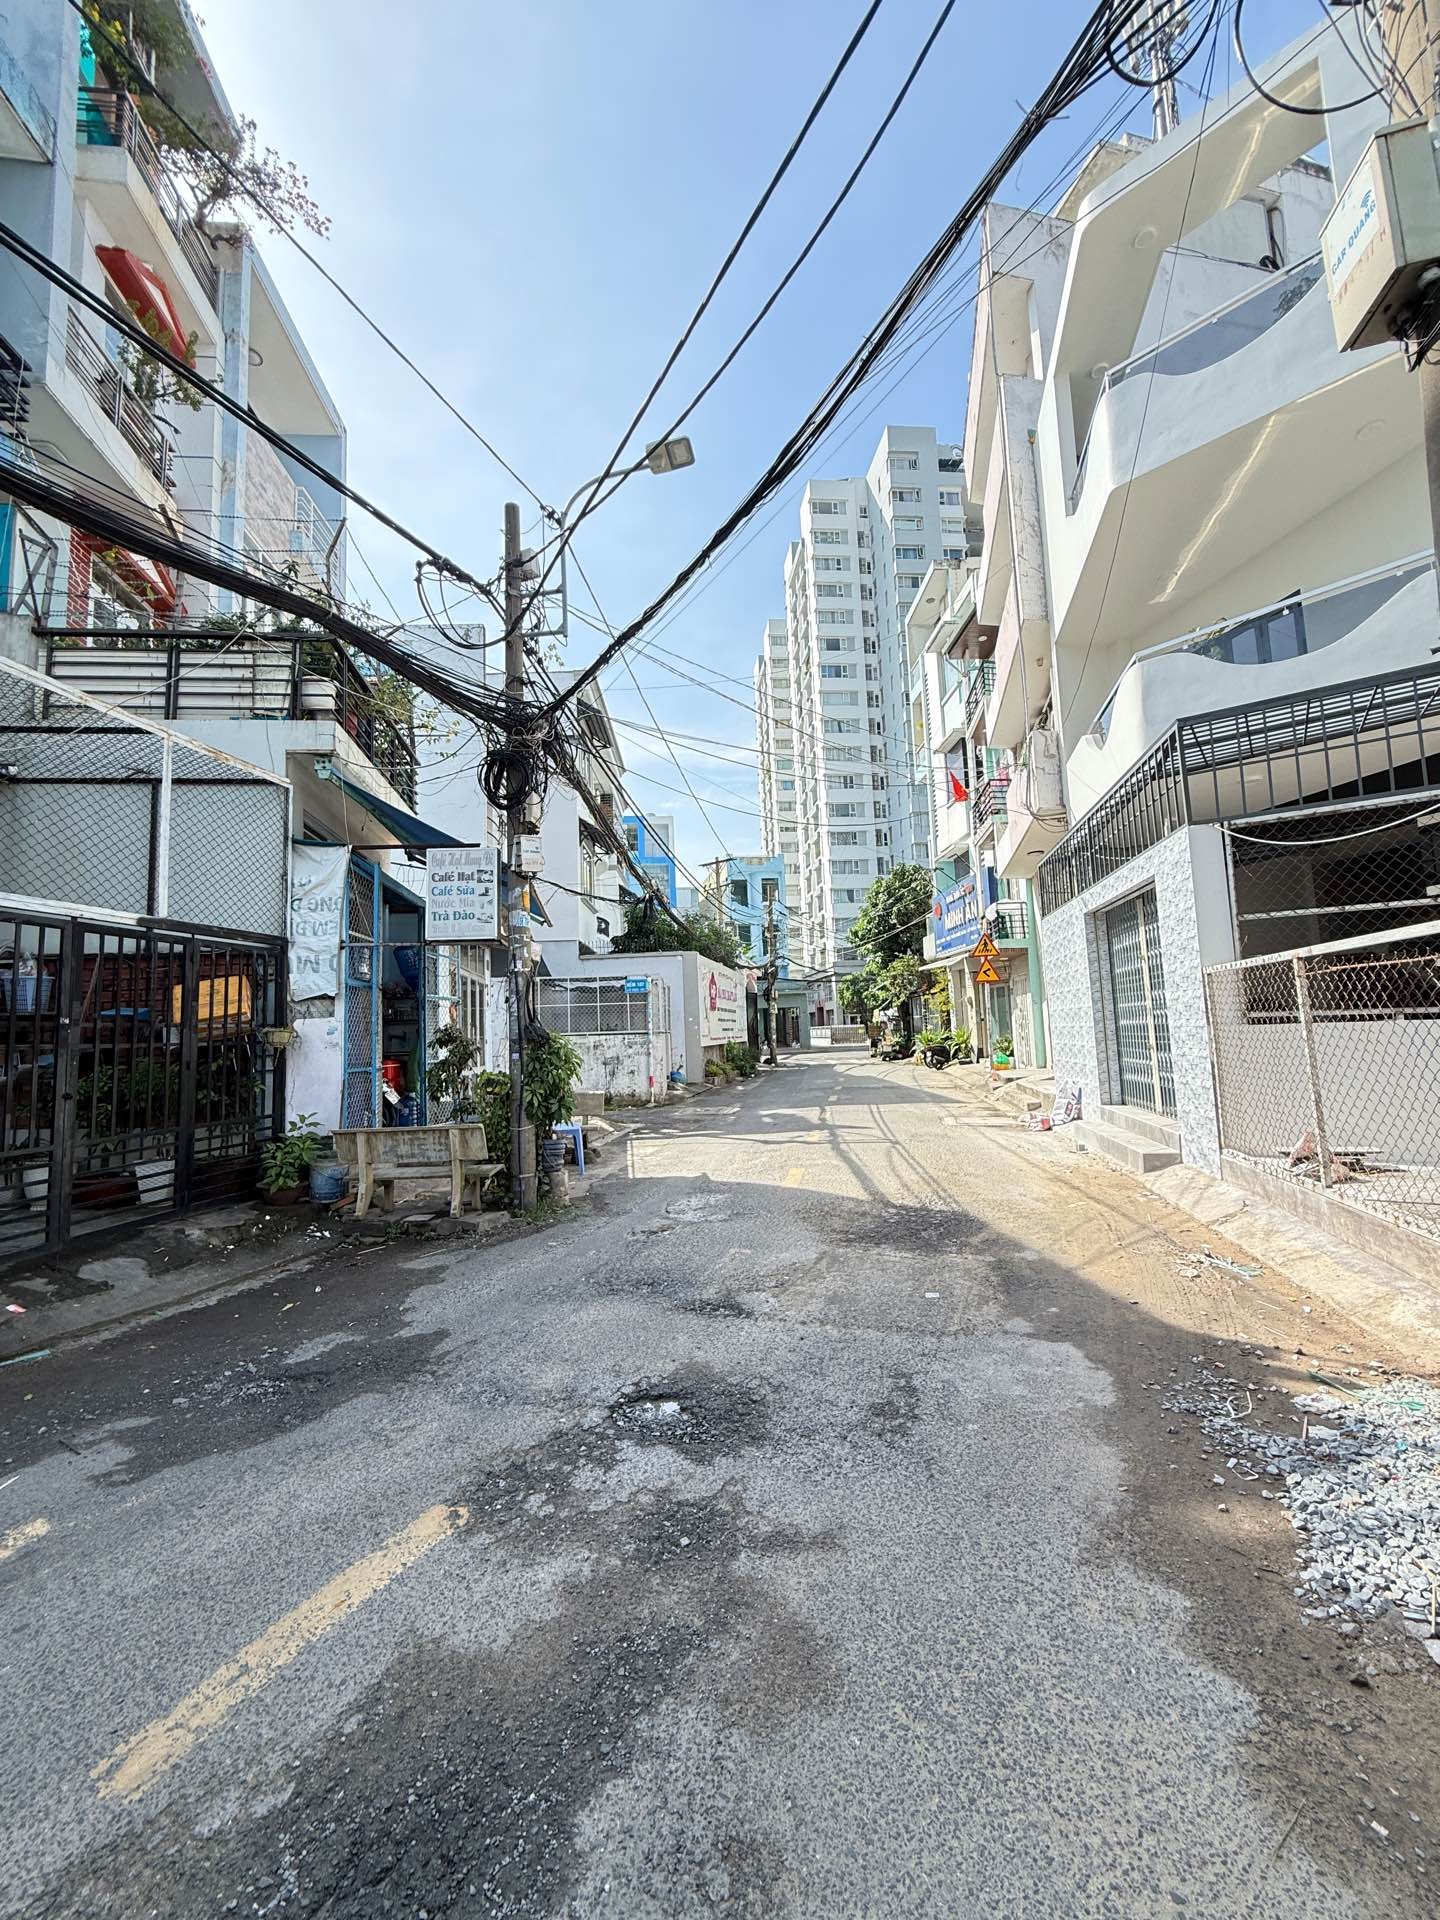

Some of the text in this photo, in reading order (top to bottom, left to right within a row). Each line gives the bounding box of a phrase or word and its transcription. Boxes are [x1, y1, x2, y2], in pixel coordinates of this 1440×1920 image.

[431, 871, 476, 884] Café Hạt
[431, 885, 453, 897] Café
[431, 910, 450, 921] Trà
